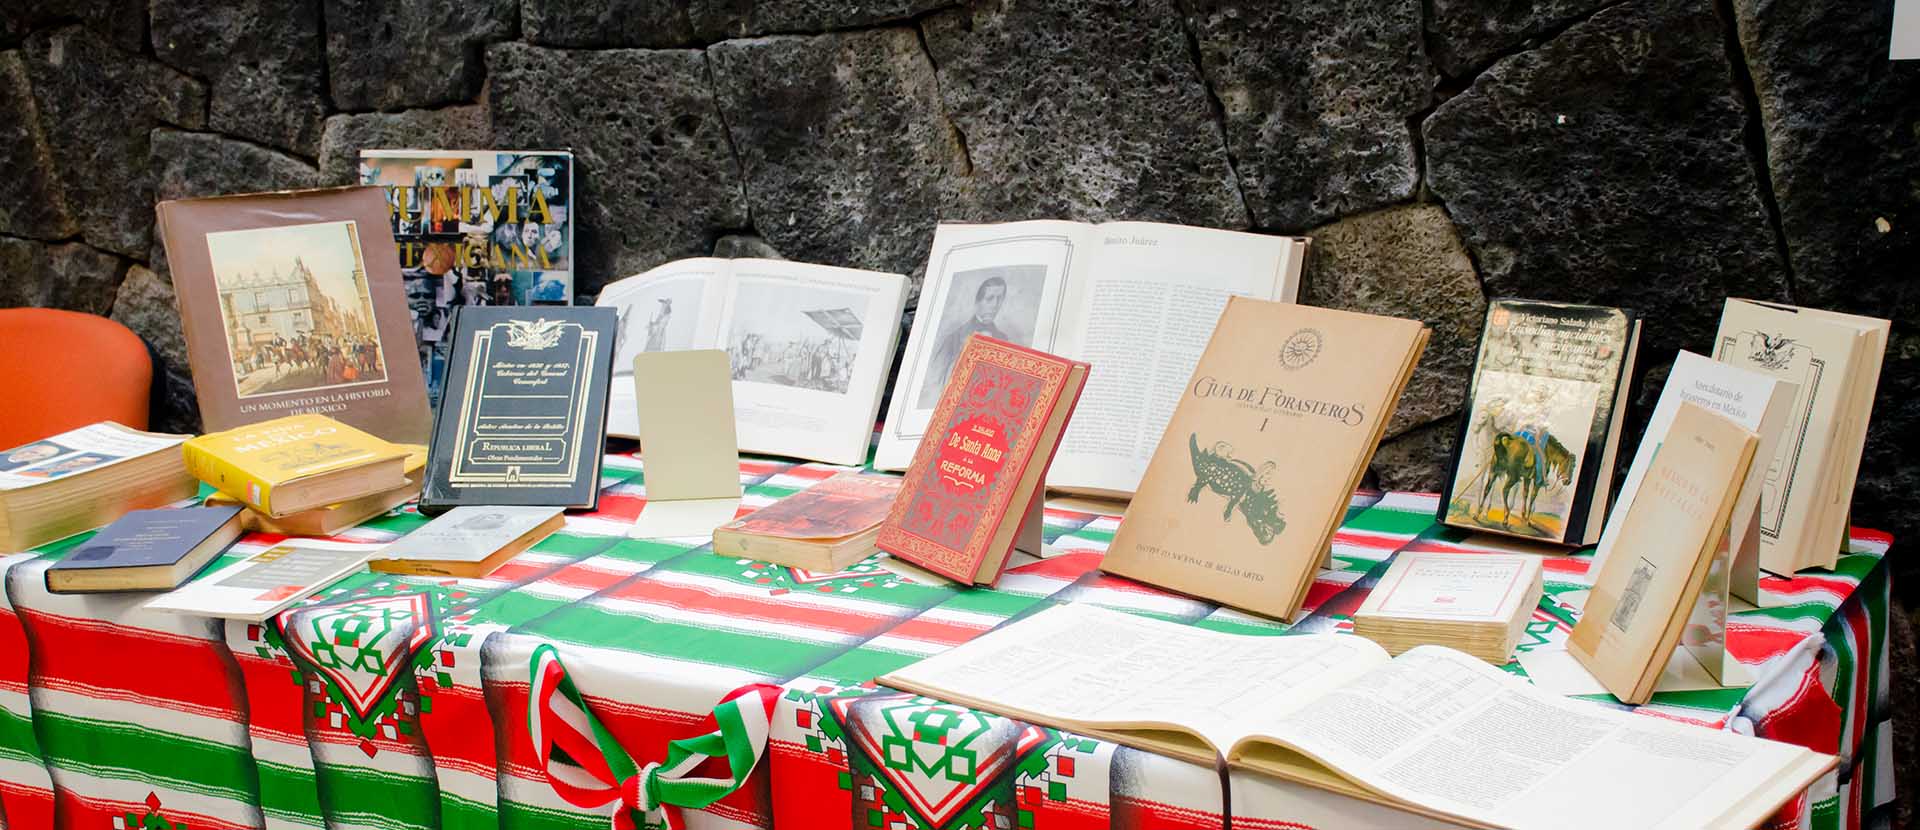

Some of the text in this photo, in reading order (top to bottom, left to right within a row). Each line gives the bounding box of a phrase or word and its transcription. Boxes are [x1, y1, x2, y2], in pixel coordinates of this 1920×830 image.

[1130, 234, 1159, 248] Juárez
[396, 241, 553, 271] EXICANA
[1520, 312, 1559, 325] Victoriano
[1560, 316, 1586, 328] Salado
[240, 388, 391, 414] UN MOMENTO EN LA HISTORIA
[1237, 387, 1257, 402] DE
[1258, 386, 1366, 427] FORASTEROS
[1260, 418, 1268, 432] I
[948, 432, 1002, 463] De Santa Anna
[940, 460, 986, 485] REFORMA
[1242, 570, 1265, 583] ARTES
